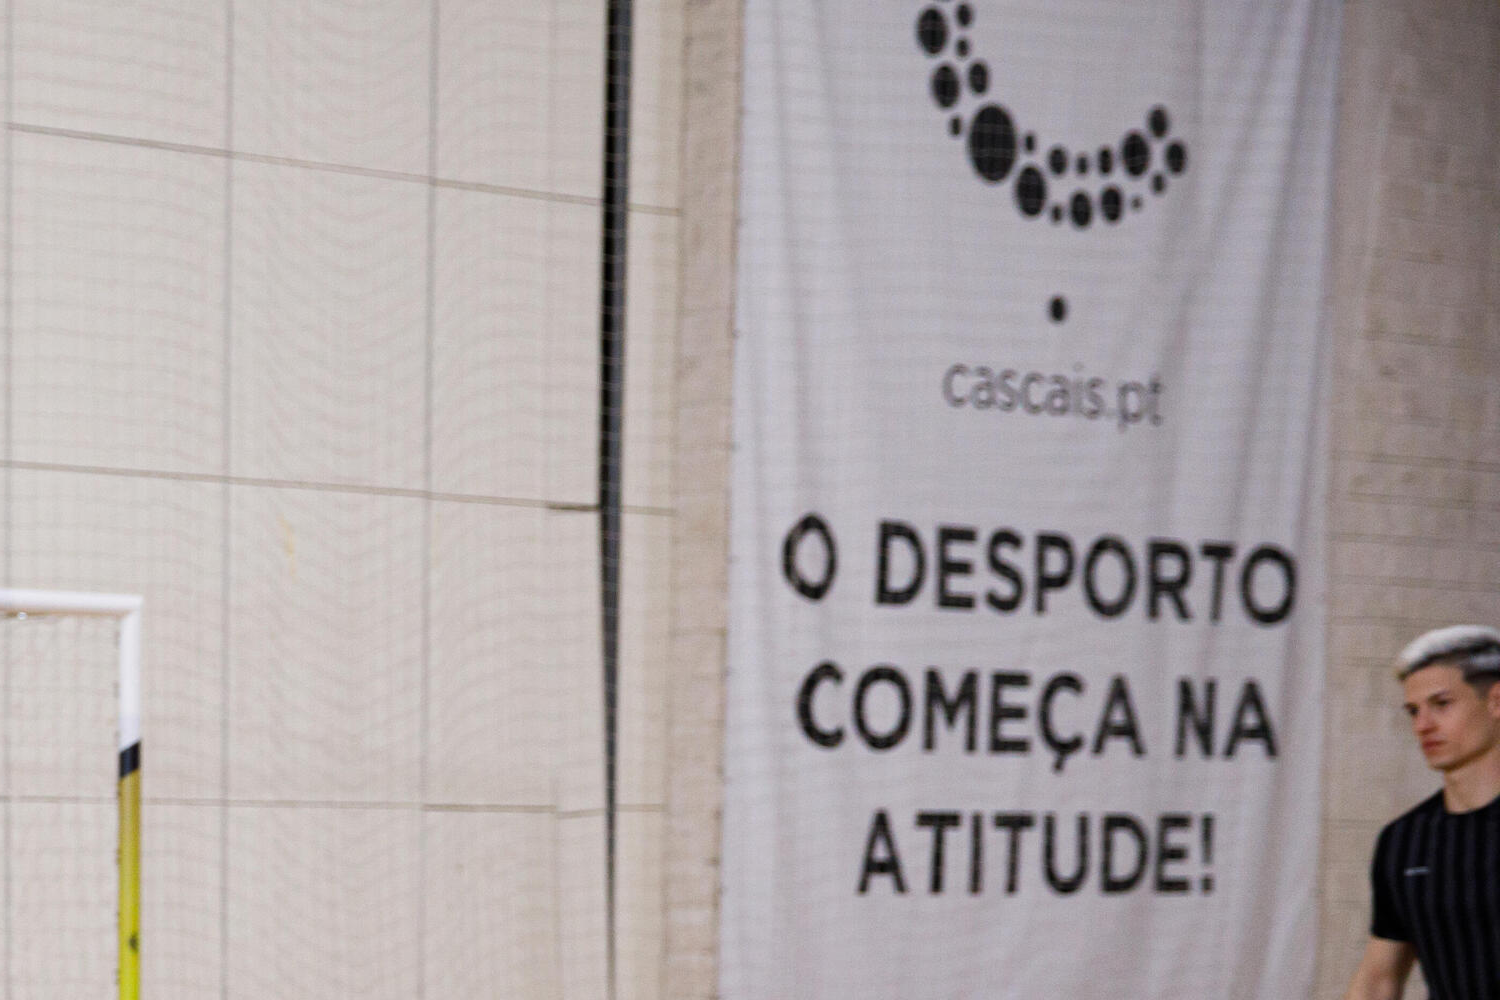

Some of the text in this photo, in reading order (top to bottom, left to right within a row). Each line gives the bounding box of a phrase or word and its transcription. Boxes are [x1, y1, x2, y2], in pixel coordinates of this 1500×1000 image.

[942, 360, 1165, 434] cascais.pt
[782, 513, 1298, 627] O DESPORTO
[797, 661, 1279, 774] COMEÇA NA
[857, 809, 1216, 896] ATITUDE!
